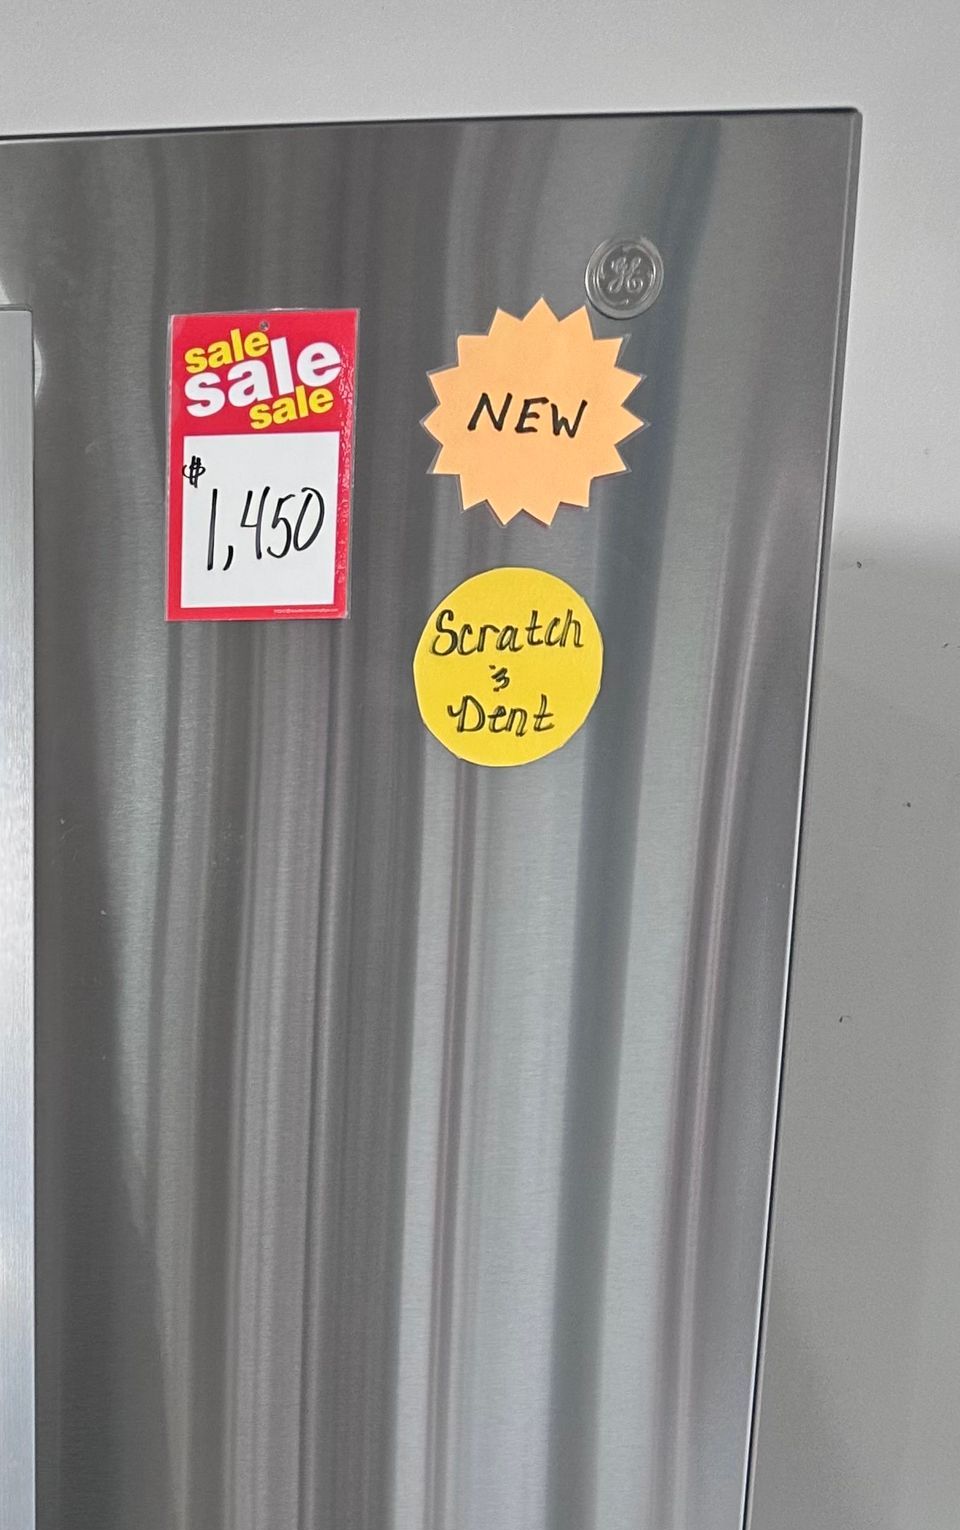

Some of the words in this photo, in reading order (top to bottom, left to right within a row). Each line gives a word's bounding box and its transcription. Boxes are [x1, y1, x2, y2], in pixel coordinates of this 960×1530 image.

[184, 328, 269, 374] sale
[184, 336, 341, 418] sale
[249, 385, 334, 430] sale
[467, 392, 588, 439] NEW
[428, 609, 584, 657] Scratch
[447, 694, 556, 737] Dent
